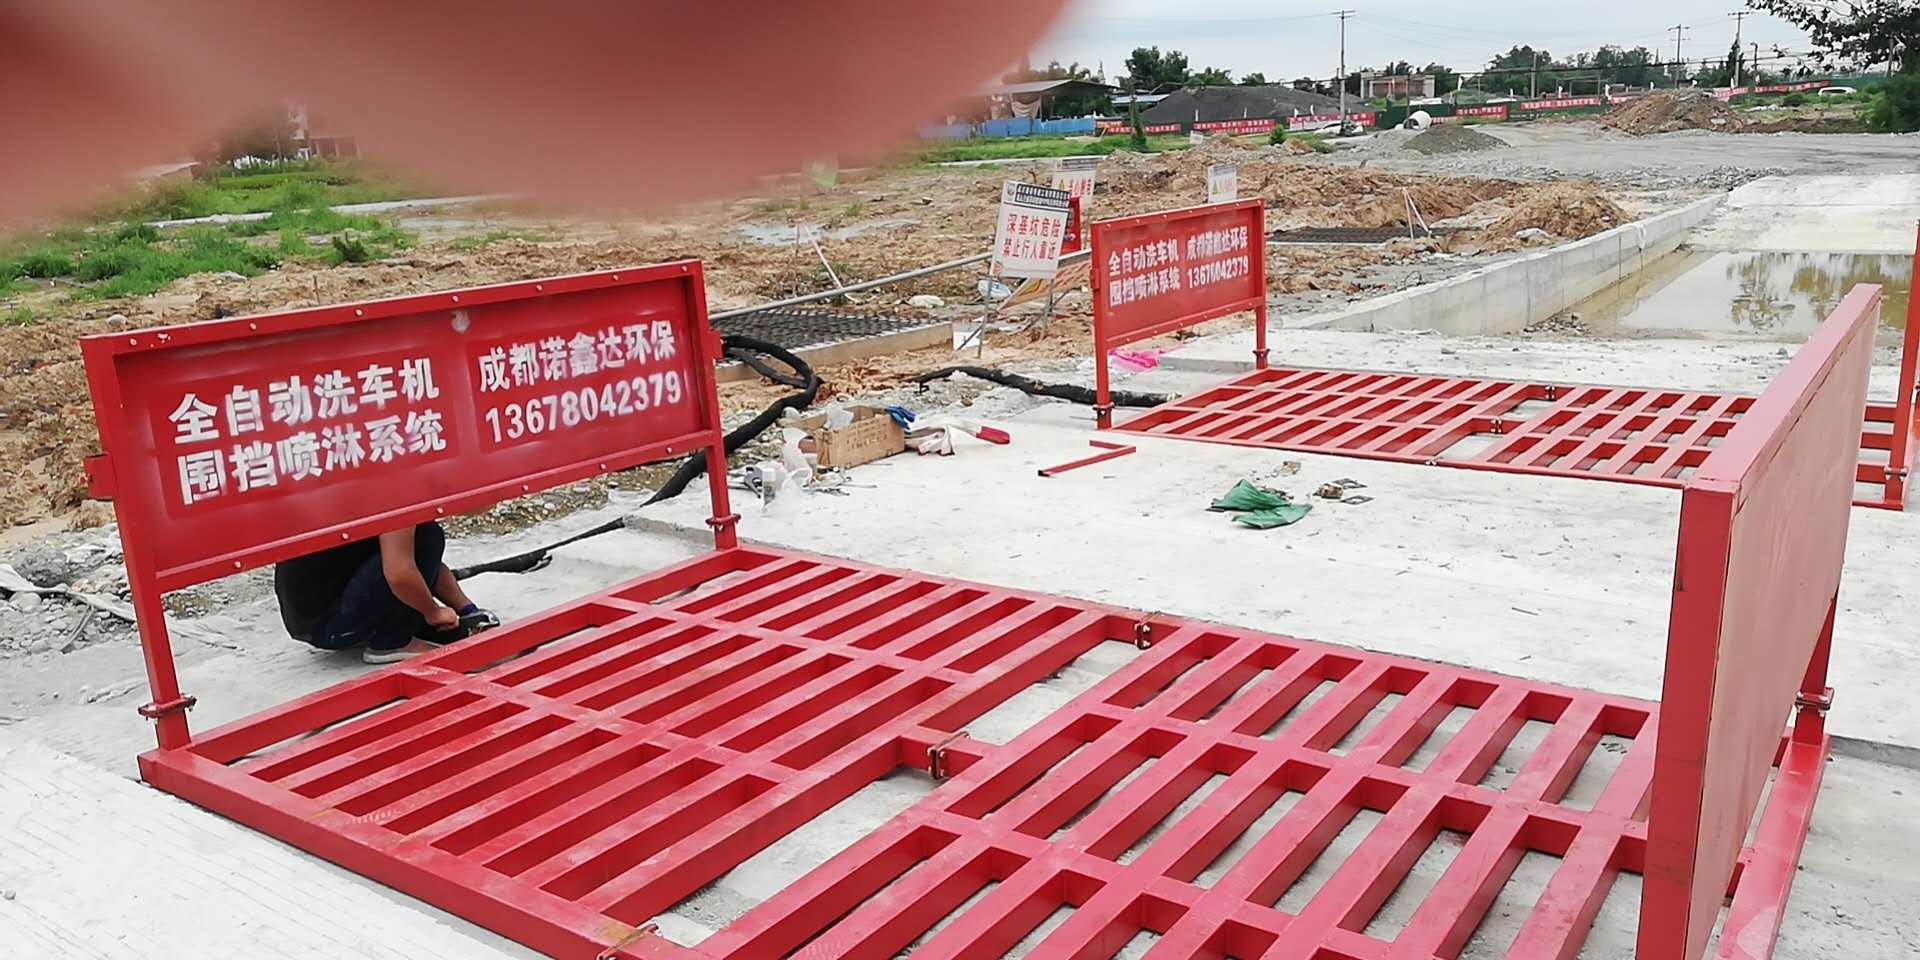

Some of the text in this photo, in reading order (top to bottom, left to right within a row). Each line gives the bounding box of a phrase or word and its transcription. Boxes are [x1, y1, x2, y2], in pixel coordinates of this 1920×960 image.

[1109, 239, 1179, 276] 全自动洗车机
[1110, 267, 1180, 307] 围挡喷淋系统
[478, 320, 676, 393] 成都诺鑫达环保
[168, 358, 440, 444] 全自动洗车机
[485, 370, 682, 443] 13678042379
[177, 409, 447, 505] 围挡喷淋系统
